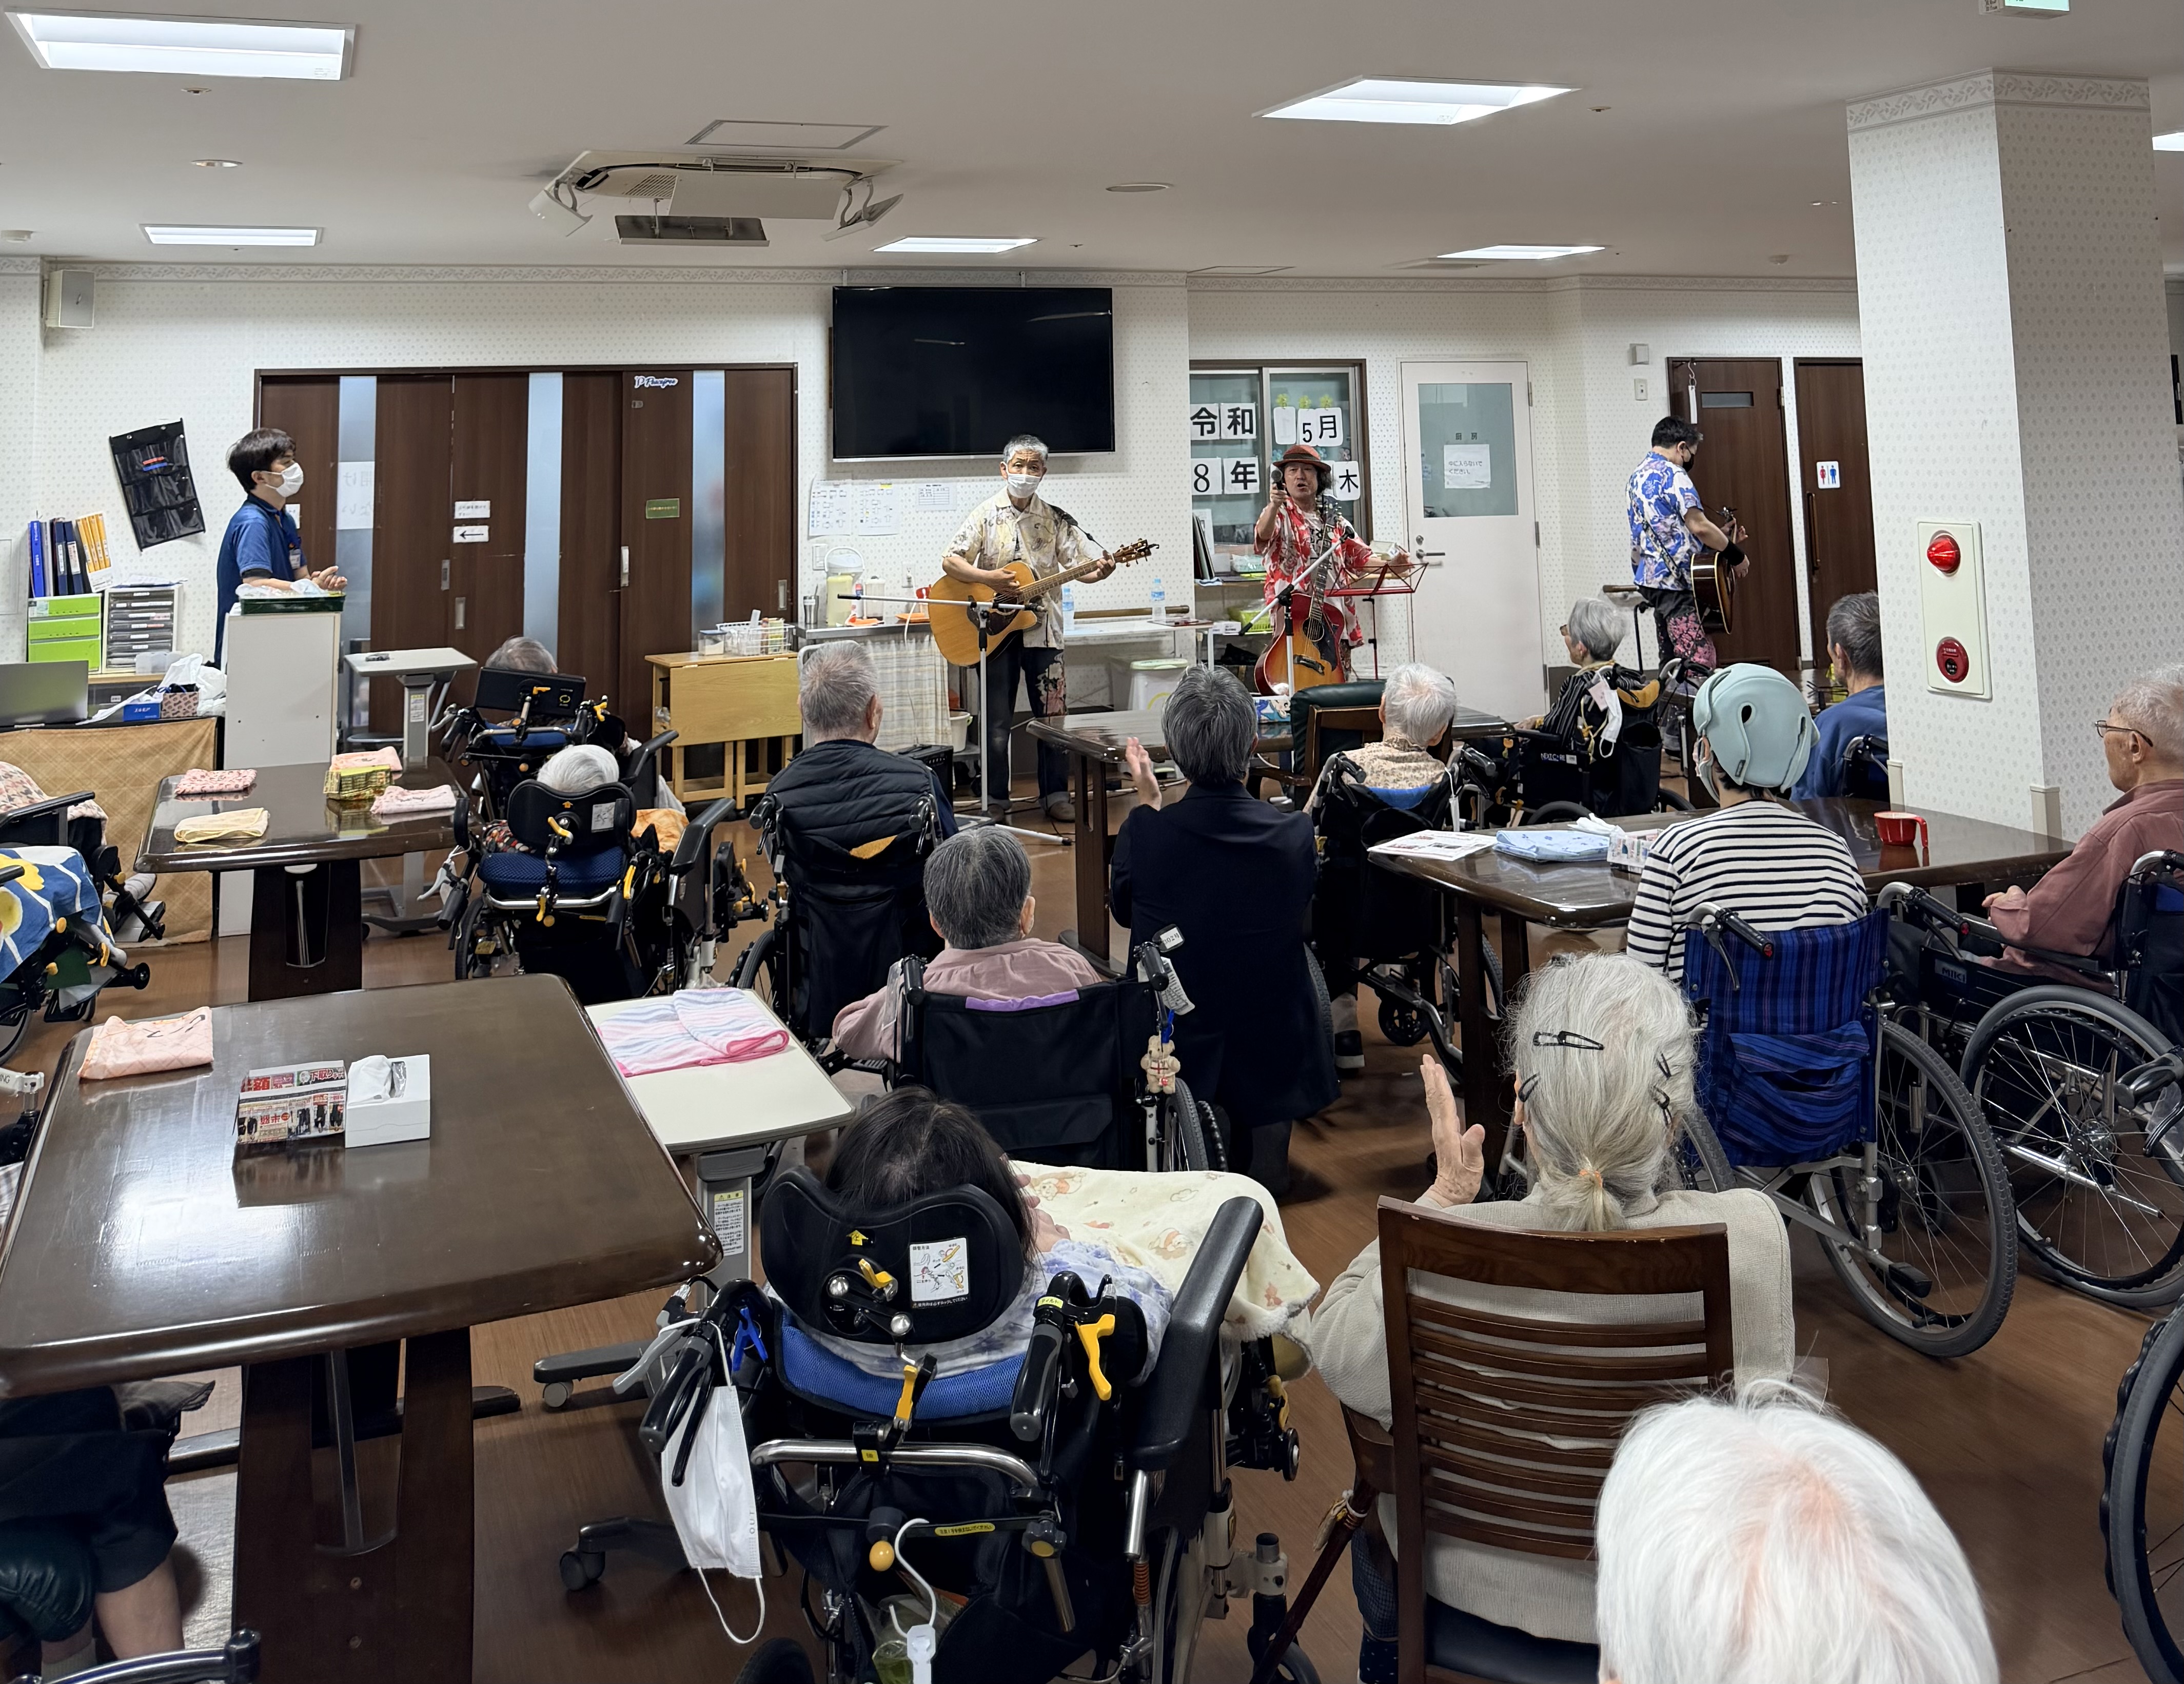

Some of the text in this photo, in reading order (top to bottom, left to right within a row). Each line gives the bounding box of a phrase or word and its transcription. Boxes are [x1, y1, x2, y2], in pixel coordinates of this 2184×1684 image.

[1190, 407, 1253, 436] 令和
[1303, 415, 1337, 443] 5月
[1194, 461, 1257, 493] 8年
[1339, 469, 1359, 493] 木
[1942, 968, 1965, 982] MIKI
